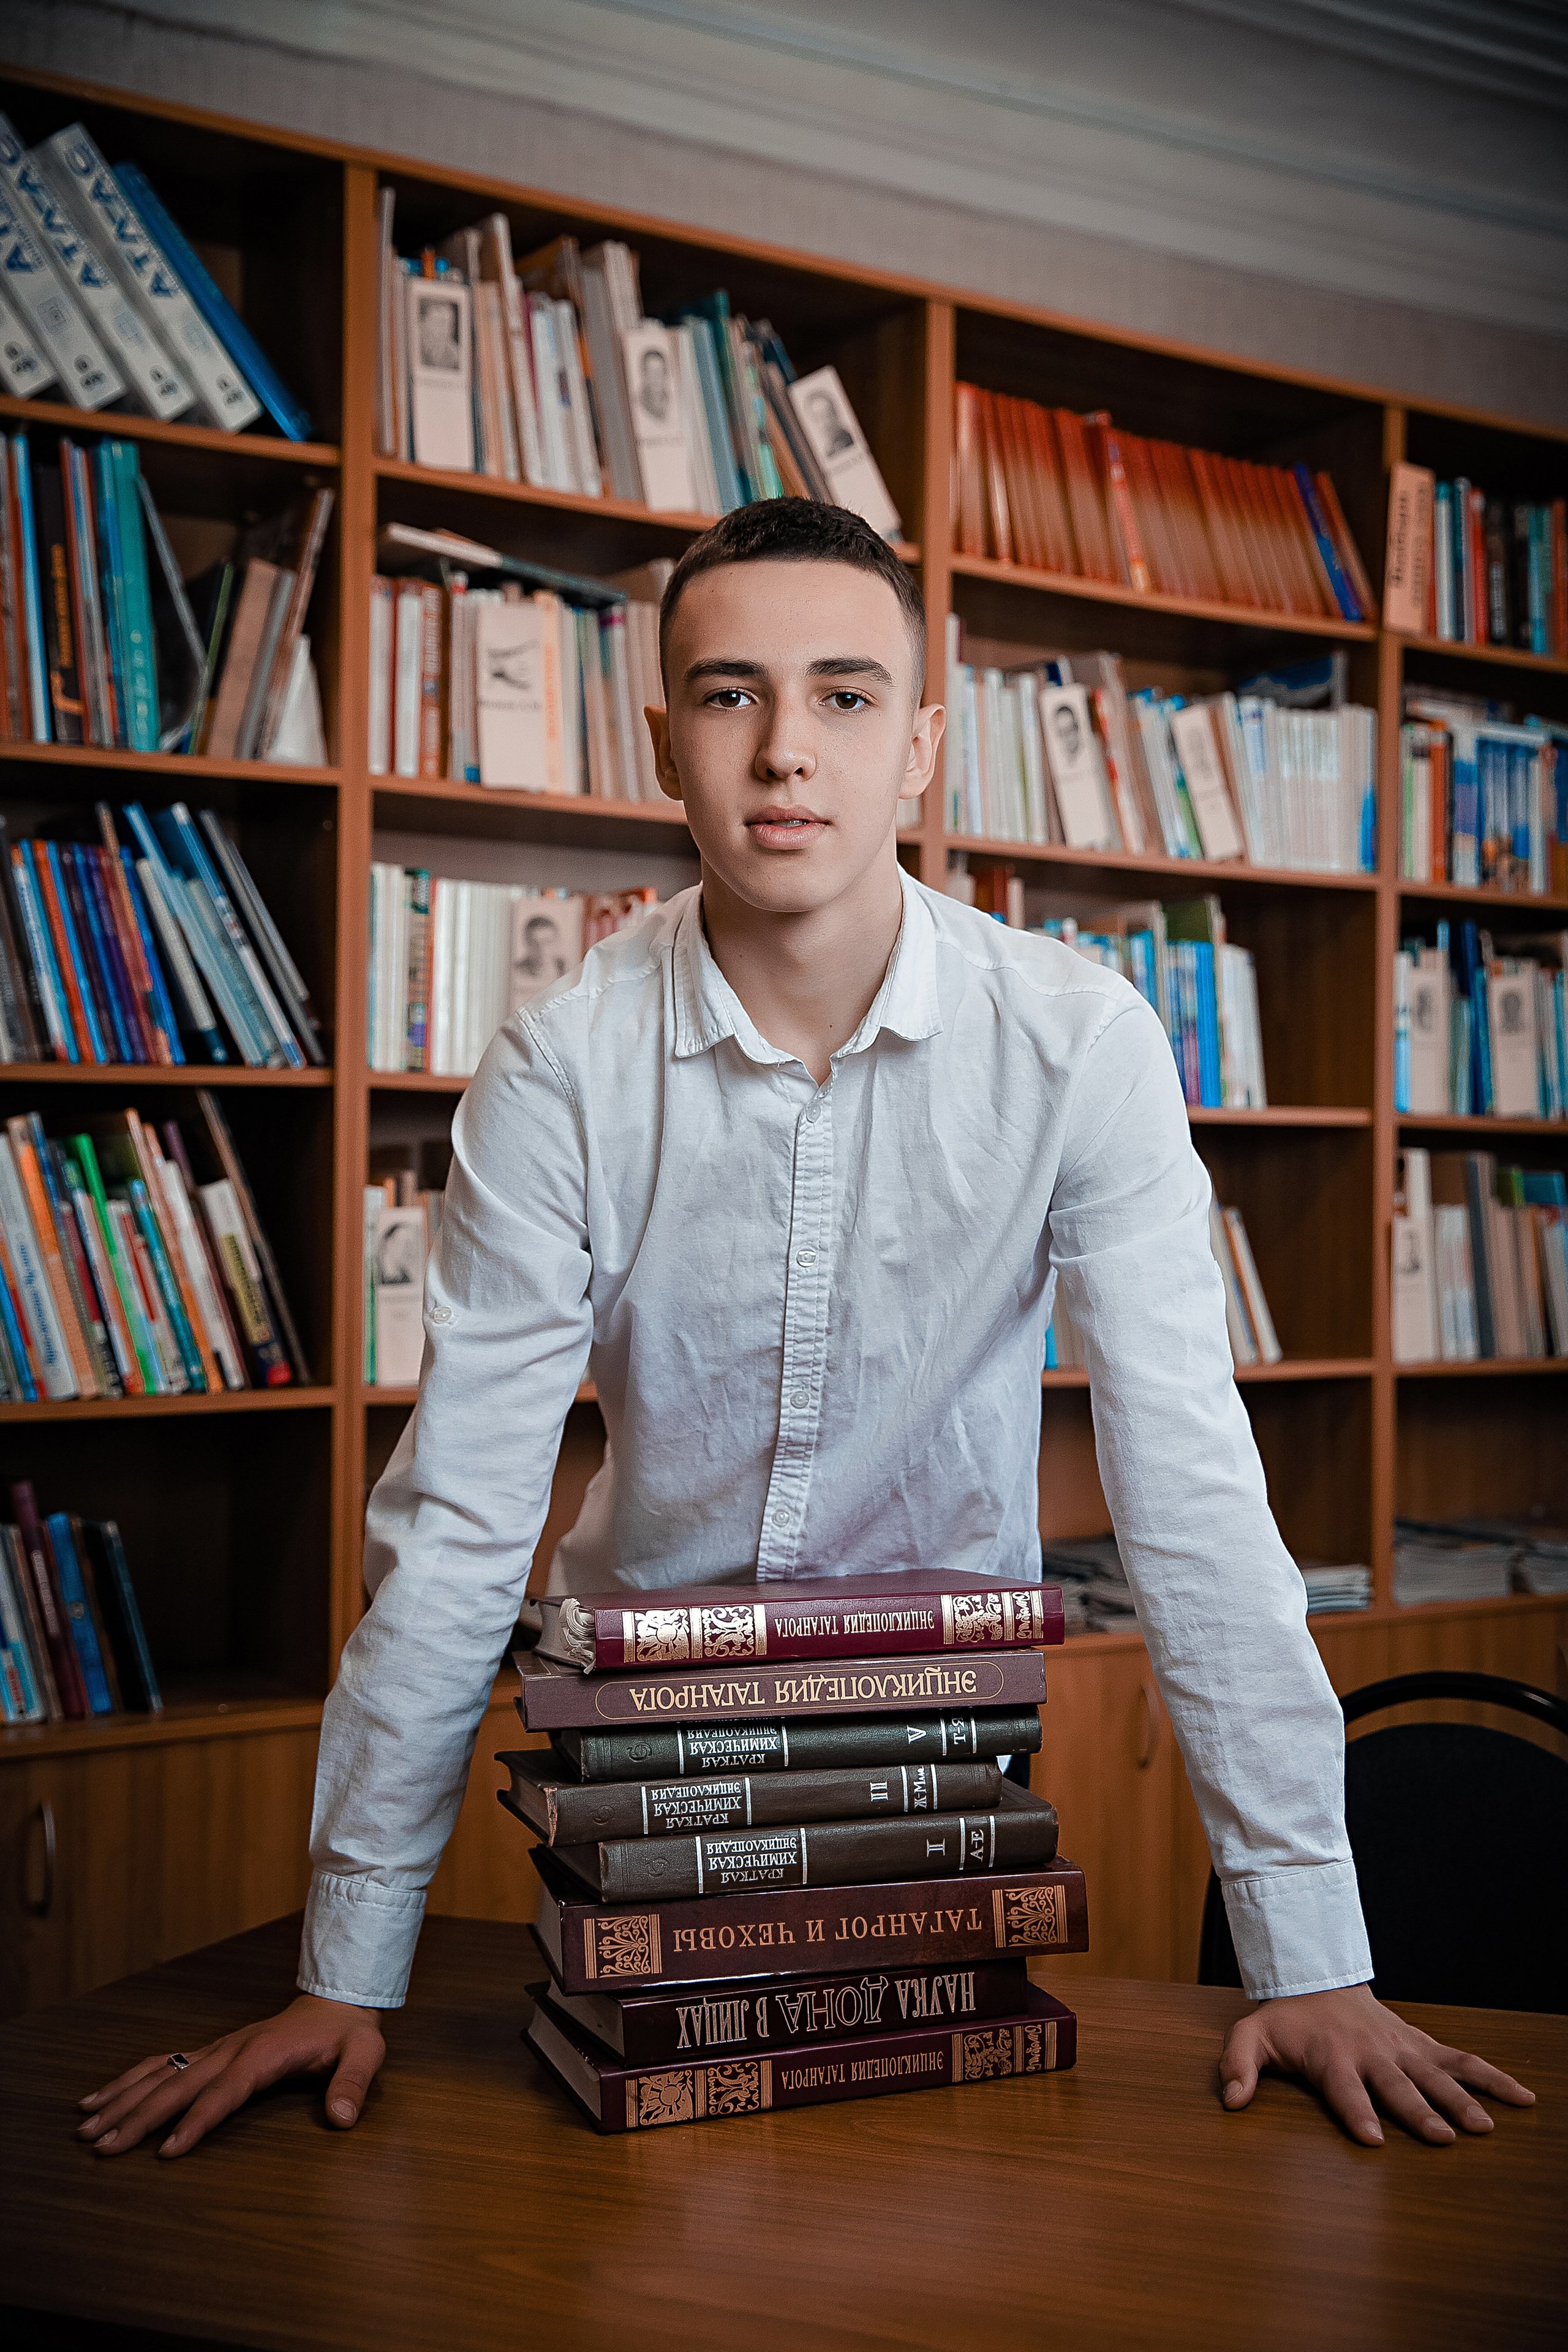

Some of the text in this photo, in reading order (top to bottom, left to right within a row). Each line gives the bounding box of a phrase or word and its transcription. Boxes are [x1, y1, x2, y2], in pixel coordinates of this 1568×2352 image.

[774, 1608, 934, 1637] ЭНЦИКЛОПЕДИЯ ТАГАНРОГА
[628, 1667, 976, 1711] ЭНЦИКЛОПЕДИЯ ТАГАНРОГА
[686, 1725, 777, 1740] ЭНЦИКЛОПЕДИЯ
[688, 1736, 778, 1755] ХИМИЧЕСКАЯ
[701, 1753, 765, 1768] КРАТКАЯ
[650, 1780, 741, 1801] ЭНЦИКЛОПЕДИЯ
[653, 1795, 742, 1816] ХИМИЧЕСКАЯ
[665, 1812, 729, 1828] КРАТКАЯ
[706, 1836, 796, 1854] ЭНЦИКЛОПЕДИЯ
[970, 1828, 984, 1862] А-Е
[707, 1851, 797, 1871] ХИМИЧЕСКАЯ
[720, 1868, 784, 1883] КРАТКАЯ
[673, 1908, 982, 1951] ТАГАНРОГ И ЧЕХОВЫ
[675, 1971, 976, 2048] НАУКА ДОНА В ЛИЦАХ
[780, 2050, 944, 2090] ЭНЦИКЛОПЕДИЯ ТАГАНРОГА
